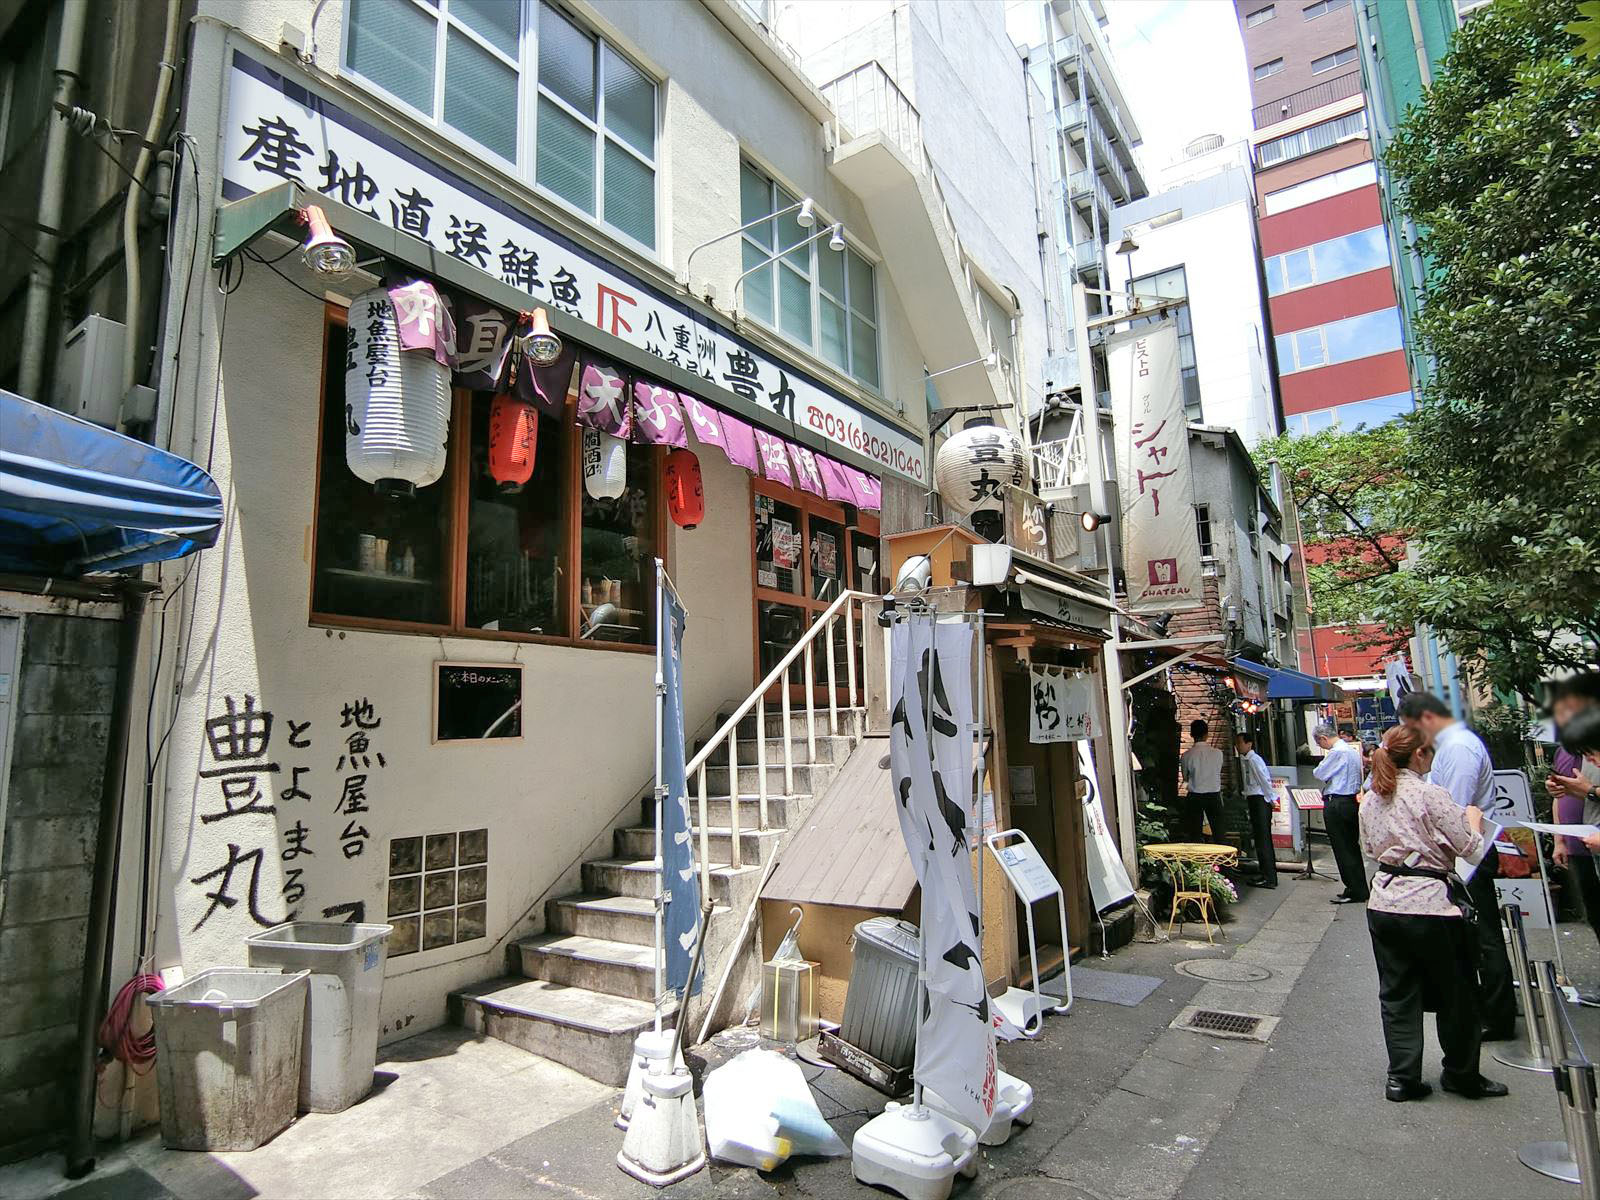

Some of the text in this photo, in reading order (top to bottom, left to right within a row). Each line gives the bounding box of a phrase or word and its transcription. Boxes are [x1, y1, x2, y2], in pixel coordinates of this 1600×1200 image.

[237, 116, 583, 320] 産地直送鮮魚
[365, 300, 392, 387] 地魚屋台
[645, 310, 716, 366] 八重洲
[1135, 339, 1149, 378] ビストロ
[583, 364, 720, 437] 天ぷら
[824, 413, 923, 481] 03(6202)1040
[1130, 419, 1178, 517] シャトー
[191, 694, 296, 932] 豊丸
[281, 718, 314, 903] とよまる
[334, 697, 387, 859] 地魚屋台
